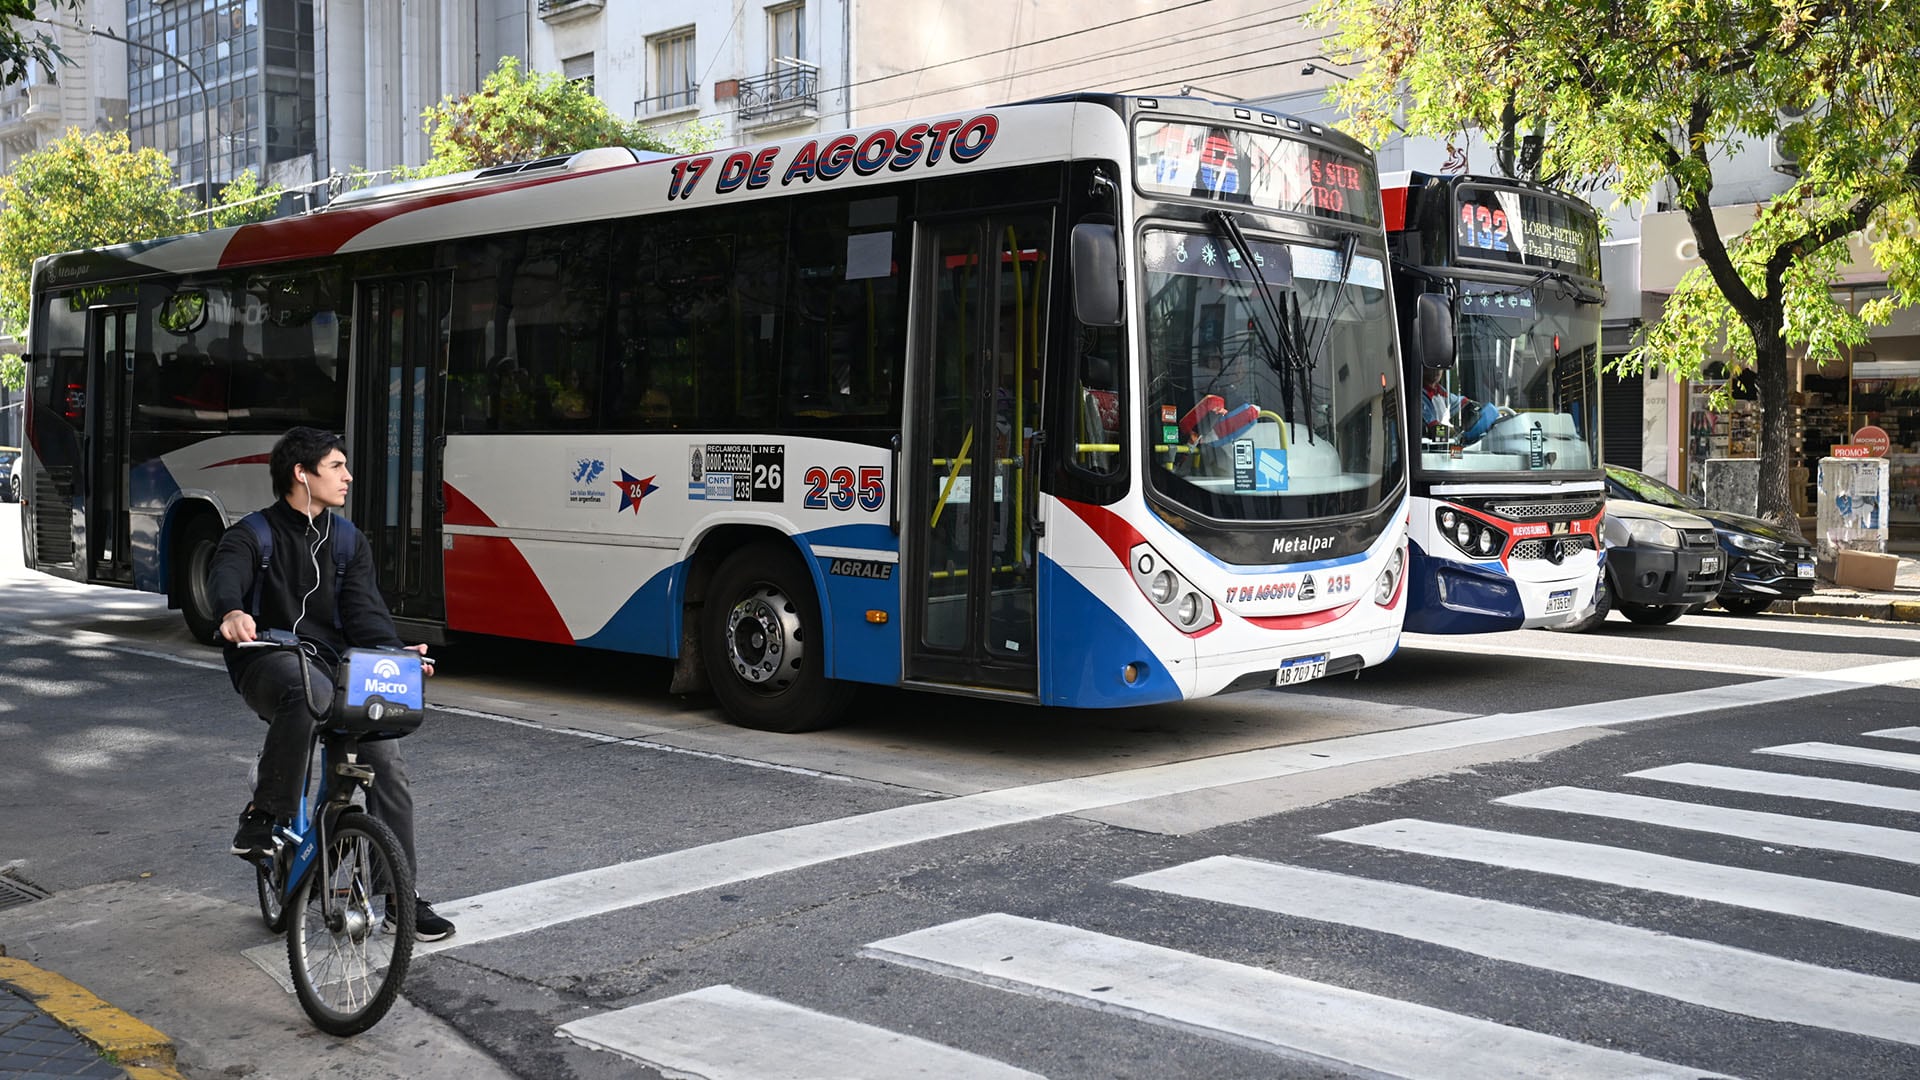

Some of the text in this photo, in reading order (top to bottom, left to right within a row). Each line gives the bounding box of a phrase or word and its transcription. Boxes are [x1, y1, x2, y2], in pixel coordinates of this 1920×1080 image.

[668, 113, 1001, 201] 17 DE AGOSTO
[1461, 203, 1509, 251] 132
[753, 446, 784, 454] LINEA
[1834, 449, 1863, 457] PROMO
[708, 477, 731, 485] CNRT
[754, 464, 782, 489] 26
[630, 484, 642, 498] 26
[736, 482, 751, 498] 235
[803, 465, 886, 512] 235
[1272, 535, 1335, 553] Metalpar
[831, 560, 891, 579] AGRALE
[1226, 582, 1297, 603] 17 DE AGOSTO
[1327, 575, 1351, 595] 235
[1280, 668, 1292, 684] AB
[364, 679, 408, 694] Macro
